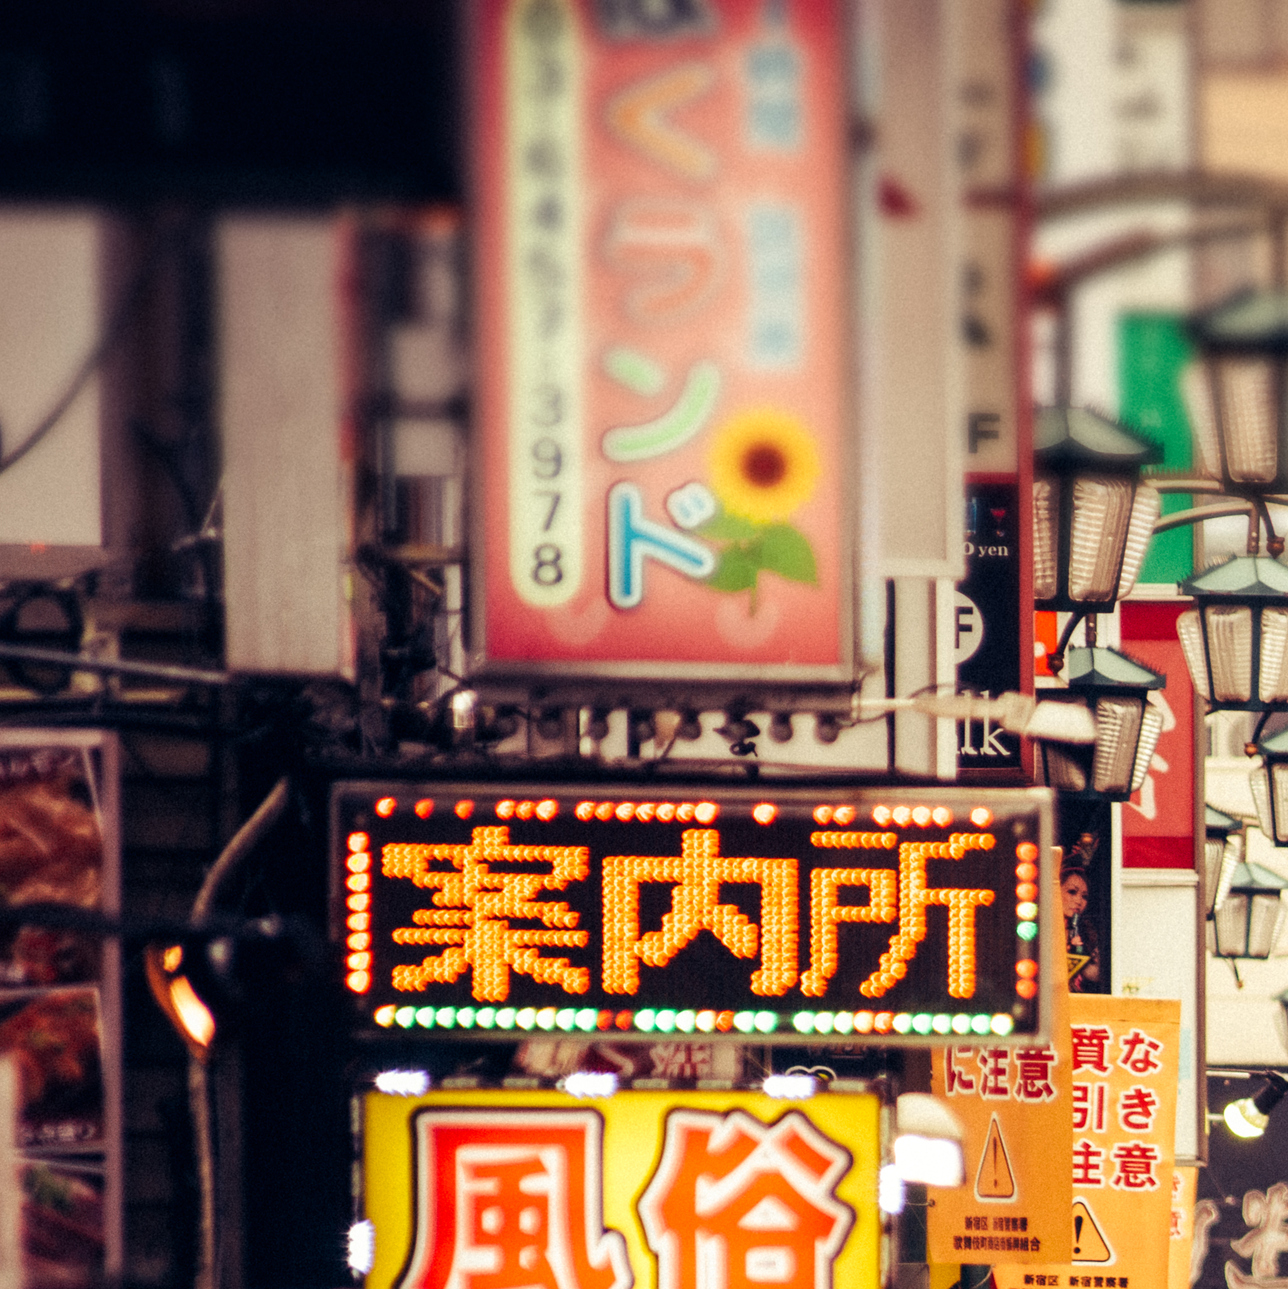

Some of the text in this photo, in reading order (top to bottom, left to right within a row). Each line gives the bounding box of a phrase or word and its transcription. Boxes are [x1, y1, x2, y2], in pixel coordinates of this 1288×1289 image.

[979, 544, 1009, 557] yen
[381, 824, 996, 1002] 案内所
